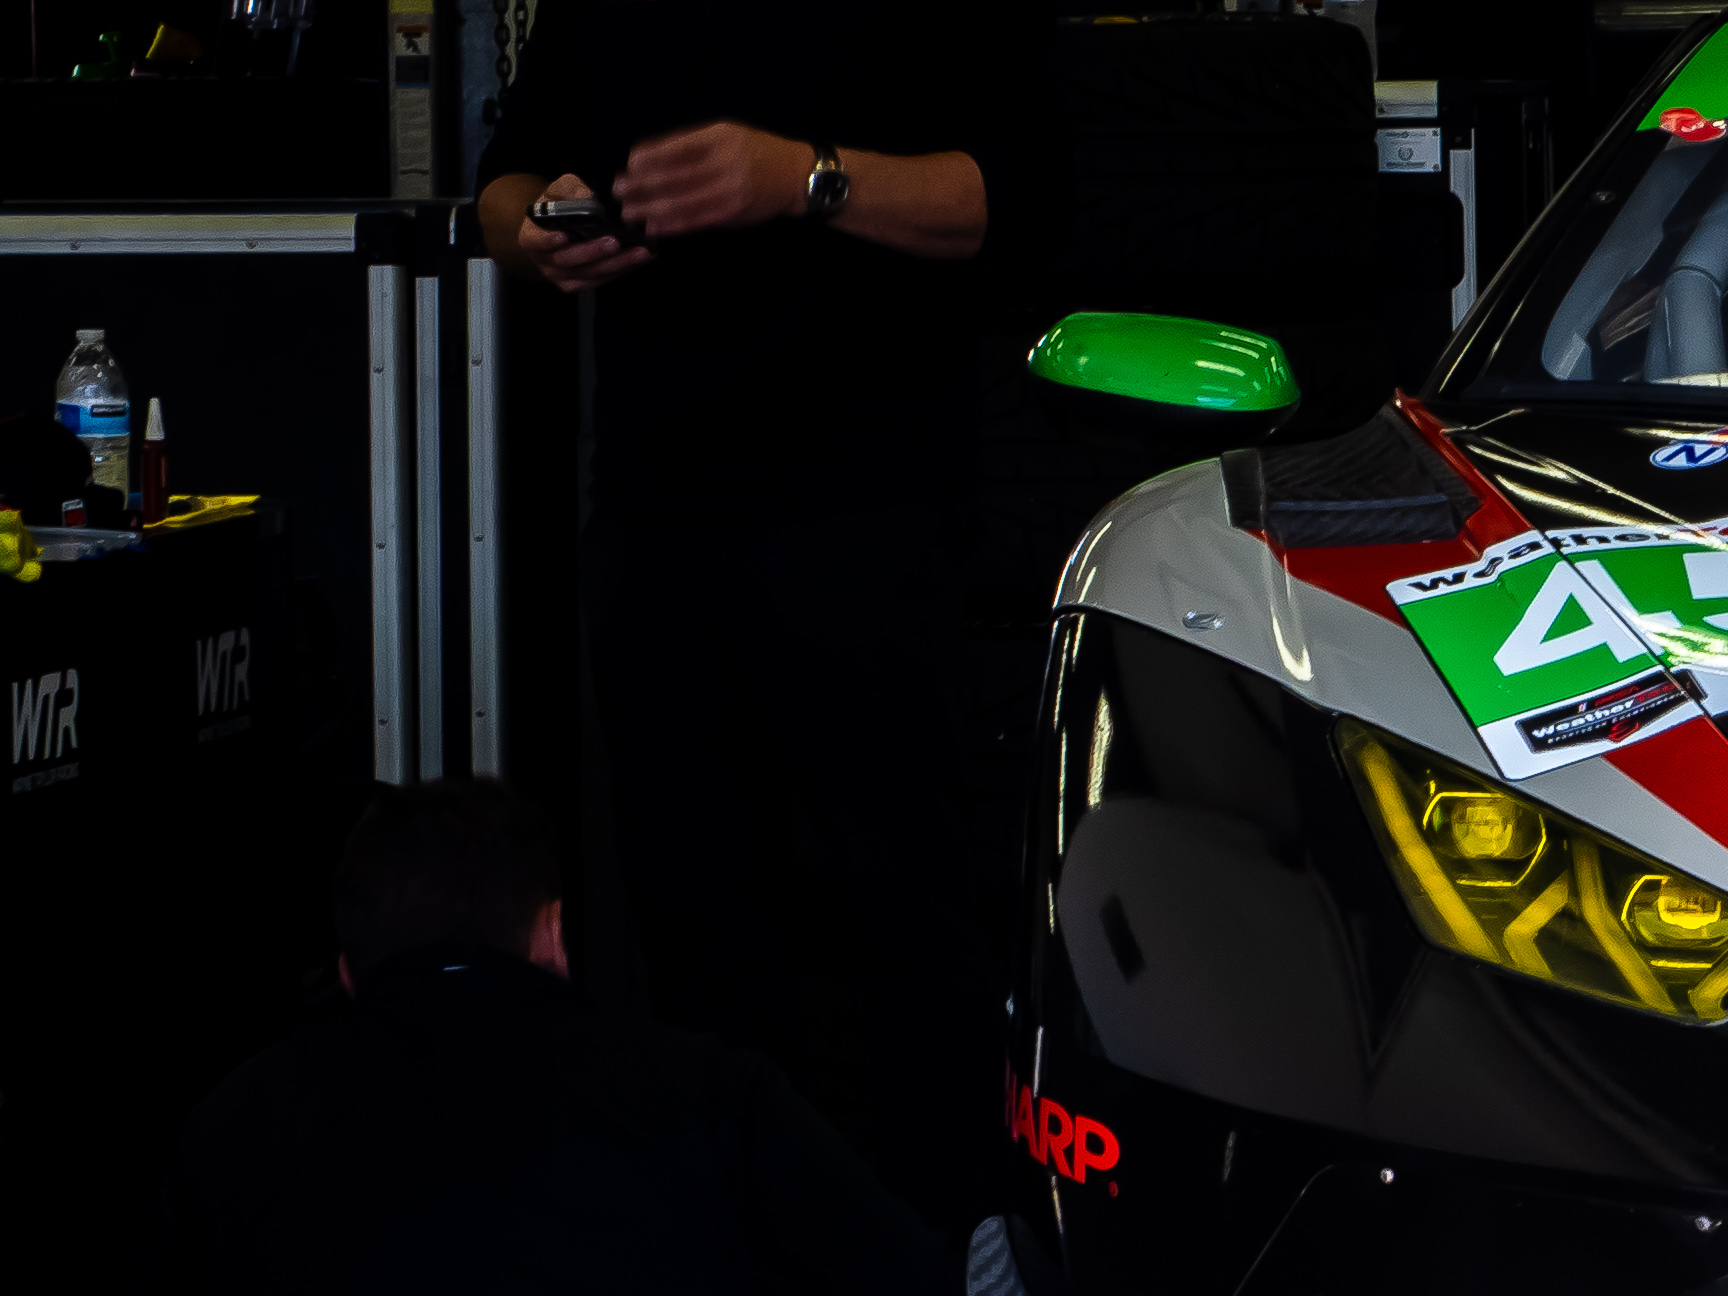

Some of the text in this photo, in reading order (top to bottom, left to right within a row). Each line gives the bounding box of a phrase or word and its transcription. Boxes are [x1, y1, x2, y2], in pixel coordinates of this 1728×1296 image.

[1660, 444, 1720, 465] N
[11, 666, 80, 766] WTR
[196, 625, 252, 717] WTR
